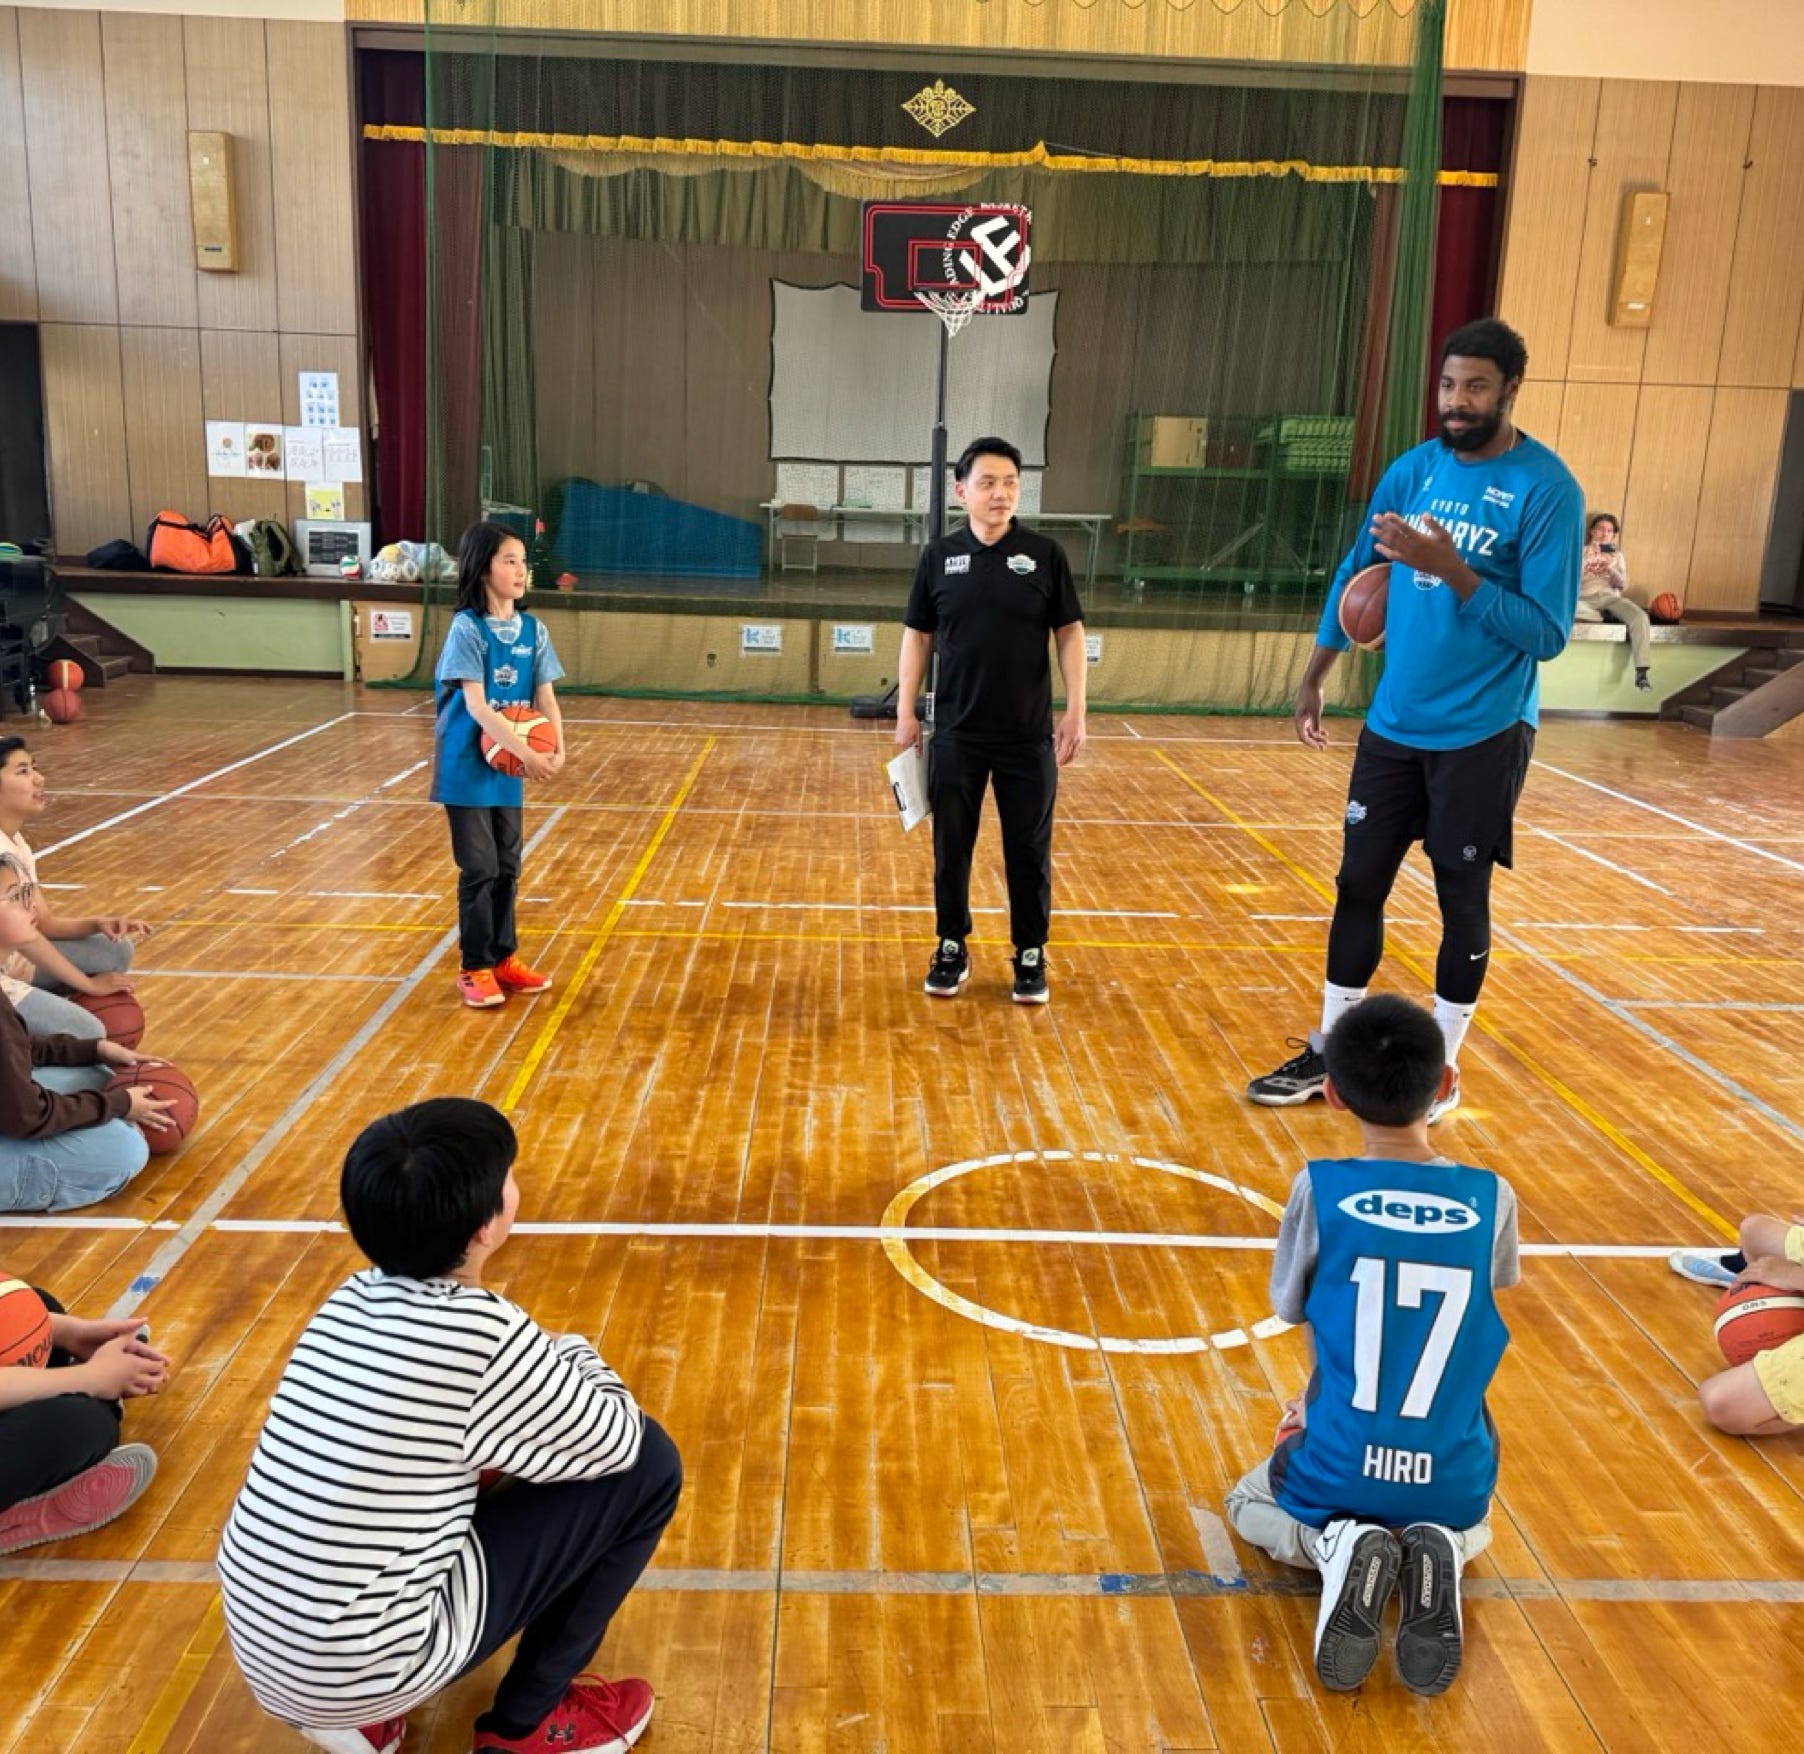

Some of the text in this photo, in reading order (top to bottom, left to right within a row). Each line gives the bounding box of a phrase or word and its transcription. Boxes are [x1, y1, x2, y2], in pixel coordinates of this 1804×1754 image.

[1354, 1194, 1469, 1226] deps
[1349, 1256, 1473, 1419] 17
[1362, 1444, 1433, 1485] HIRO
